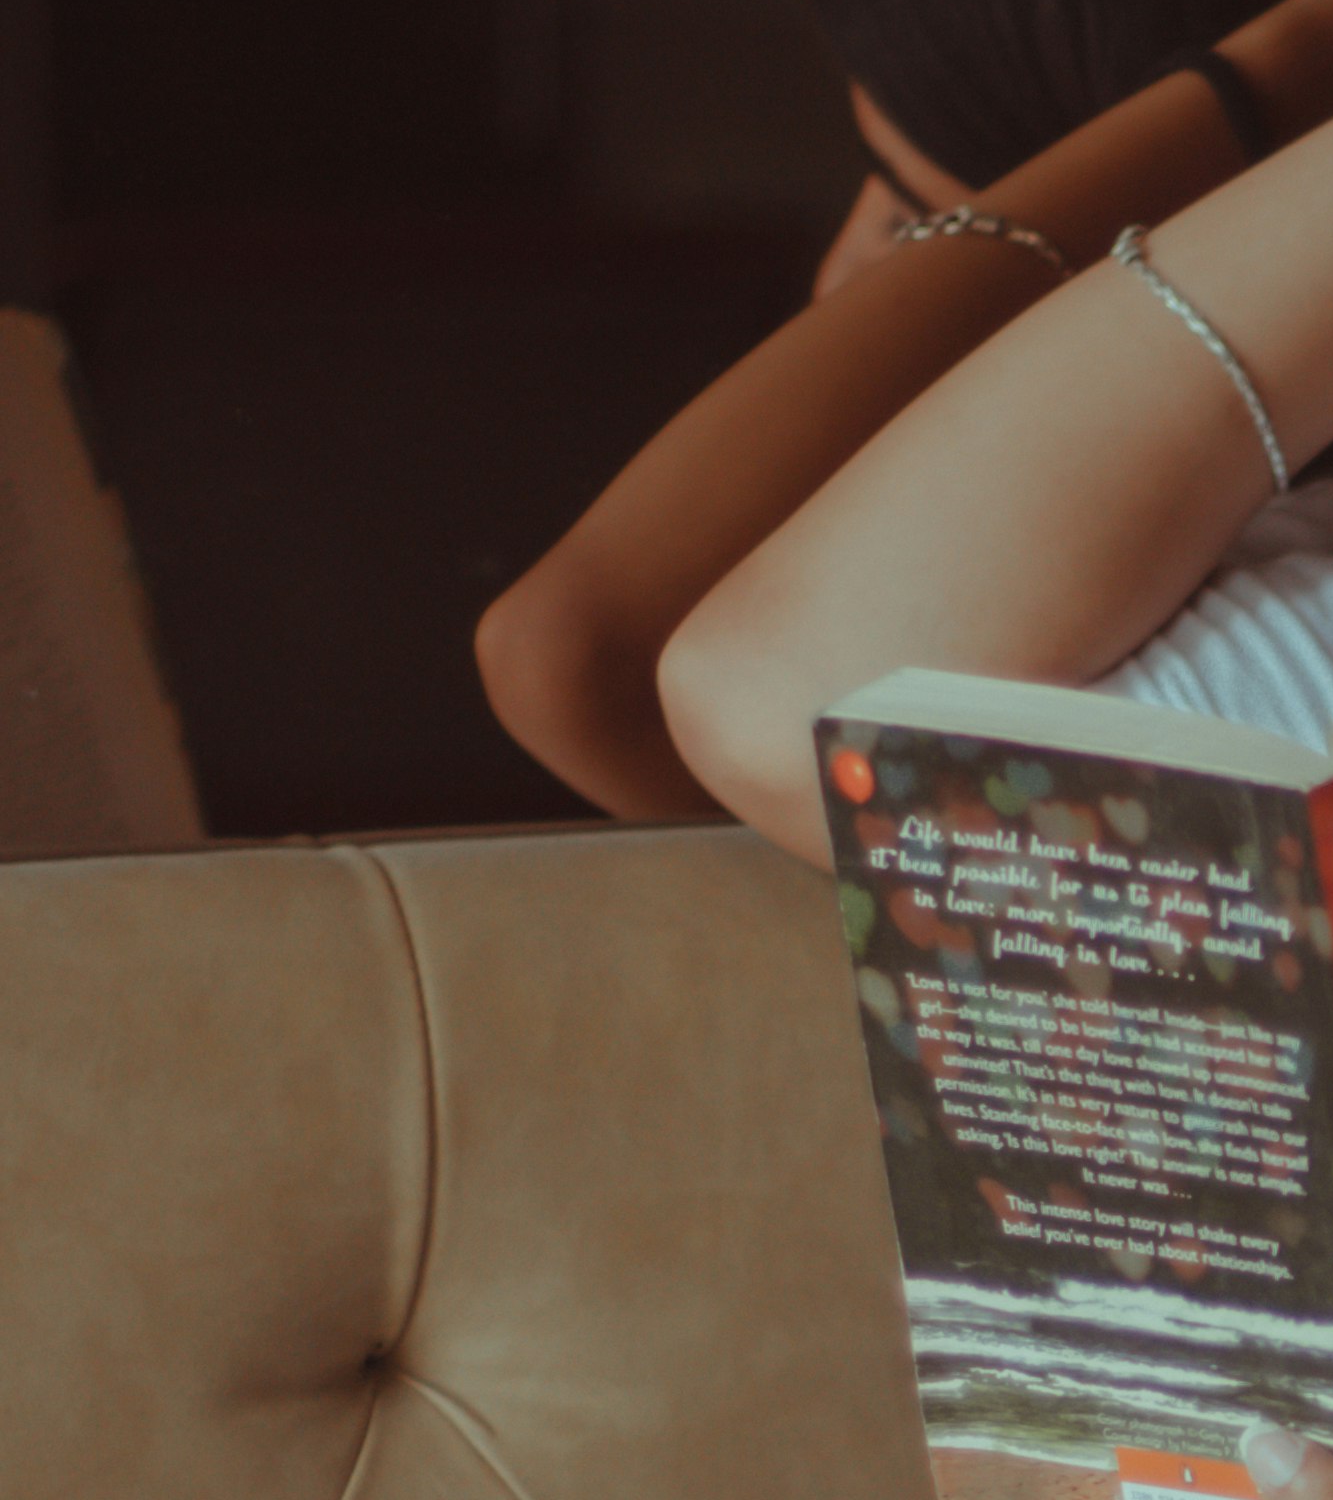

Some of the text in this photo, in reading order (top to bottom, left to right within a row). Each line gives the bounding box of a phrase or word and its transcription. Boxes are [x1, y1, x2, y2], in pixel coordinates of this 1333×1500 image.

[899, 814, 1253, 892] Life would have been easier had
[869, 847, 1294, 942] it been possible for us to plan falling
[913, 886, 937, 909] in
[1007, 905, 1058, 925] more
[1203, 937, 1263, 960] avoid
[993, 929, 1068, 968] falling
[1077, 944, 1100, 965] in
[947, 979, 960, 994] is
[963, 984, 988, 998] not
[990, 983, 1012, 1001] for
[1052, 993, 1077, 1011] she
[1080, 998, 1110, 1016] told
[1248, 1023, 1273, 1045] like
[1275, 1033, 1300, 1053] any
[985, 1008, 1038, 1029] desired
[1040, 1018, 1058, 1033] to
[1060, 1018, 1080, 1036] be
[1124, 1026, 1152, 1047] She
[1153, 1032, 1181, 1052] had
[1183, 1041, 1246, 1063] accepted
[1247, 1050, 1272, 1068] her
[916, 1024, 941, 1040] the
[943, 1030, 971, 1049] way
[974, 1031, 985, 1045] it
[1022, 1038, 1042, 1054] till
[1045, 1044, 1073, 1059] one
[1075, 1045, 1100, 1067] day
[1102, 1049, 1133, 1069] love
[1136, 1055, 1190, 1079] showed
[1192, 1068, 1212, 1085] up
[1011, 1059, 1055, 1081] That's
[1058, 1067, 1083, 1085] the
[1085, 1071, 1123, 1096] thing
[1124, 1078, 1156, 1096] with
[1261, 1102, 1292, 1121] take
[1016, 1084, 1038, 1103] It's
[1040, 1089, 1055, 1105] in
[1058, 1092, 1076, 1108] its
[1079, 1097, 1111, 1117] very
[1113, 1102, 1160, 1121] nature
[1162, 1109, 1180, 1124] to
[1251, 1124, 1280, 1142] into
[1282, 1132, 1308, 1147] our
[978, 1103, 1040, 1131] Standing
[1041, 1112, 1125, 1140] face-to-face
[1127, 1128, 1160, 1145] with
[1197, 1138, 1223, 1156] she
[1225, 1141, 1259, 1162] finds
[1022, 1135, 1049, 1153] this
[1051, 1138, 1083, 1158] love
[1128, 1149, 1159, 1169] The
[1162, 1159, 1211, 1178] answer
[1214, 1165, 1227, 1182] is
[1229, 1171, 1255, 1186] not
[1082, 1167, 1095, 1184] It
[1098, 1172, 1137, 1189] never
[1141, 1181, 1169, 1195] was
[1001, 1218, 1042, 1238] belief
[1044, 1228, 1090, 1247] you've
[1094, 1236, 1125, 1251] ever
[1127, 1237, 1155, 1256] had
[1158, 1243, 1200, 1264] about
[1005, 1194, 1279, 1257] This intense love story will shake every
